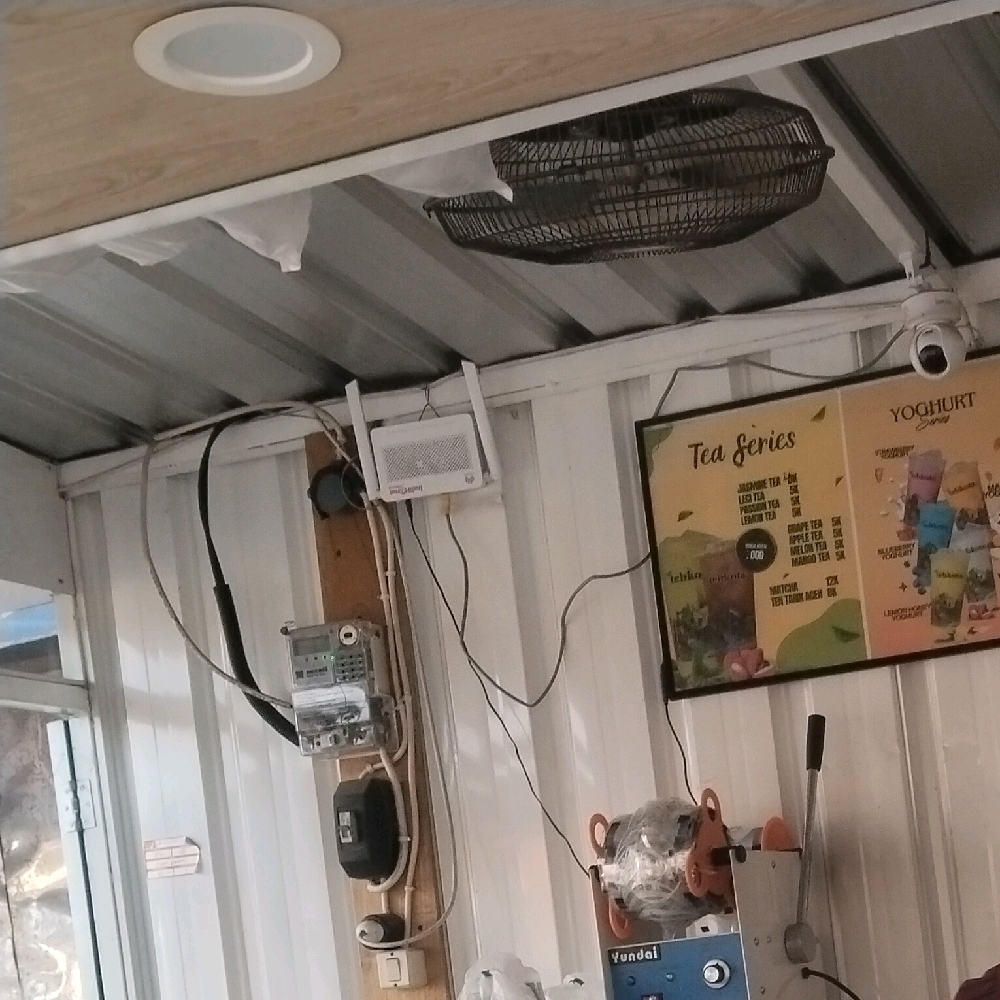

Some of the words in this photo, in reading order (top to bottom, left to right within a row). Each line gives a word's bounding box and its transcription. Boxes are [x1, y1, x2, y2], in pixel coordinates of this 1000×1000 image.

[889, 391, 976, 422] YOGHURT
[688, 441, 726, 470] Tea
[732, 430, 796, 468] Series
[769, 476, 781, 488] TEA
[753, 491, 765, 502] TEA
[768, 499, 780, 508] TEA
[765, 511, 777, 521] TEA
[810, 519, 823, 529] TEA
[810, 530, 823, 540] TEA
[814, 541, 827, 552] TEA
[818, 551, 831, 562] TEA
[769, 582, 798, 595] MATCHA
[771, 596, 784, 607] TEH
[611, 946, 658, 964] Yundai
